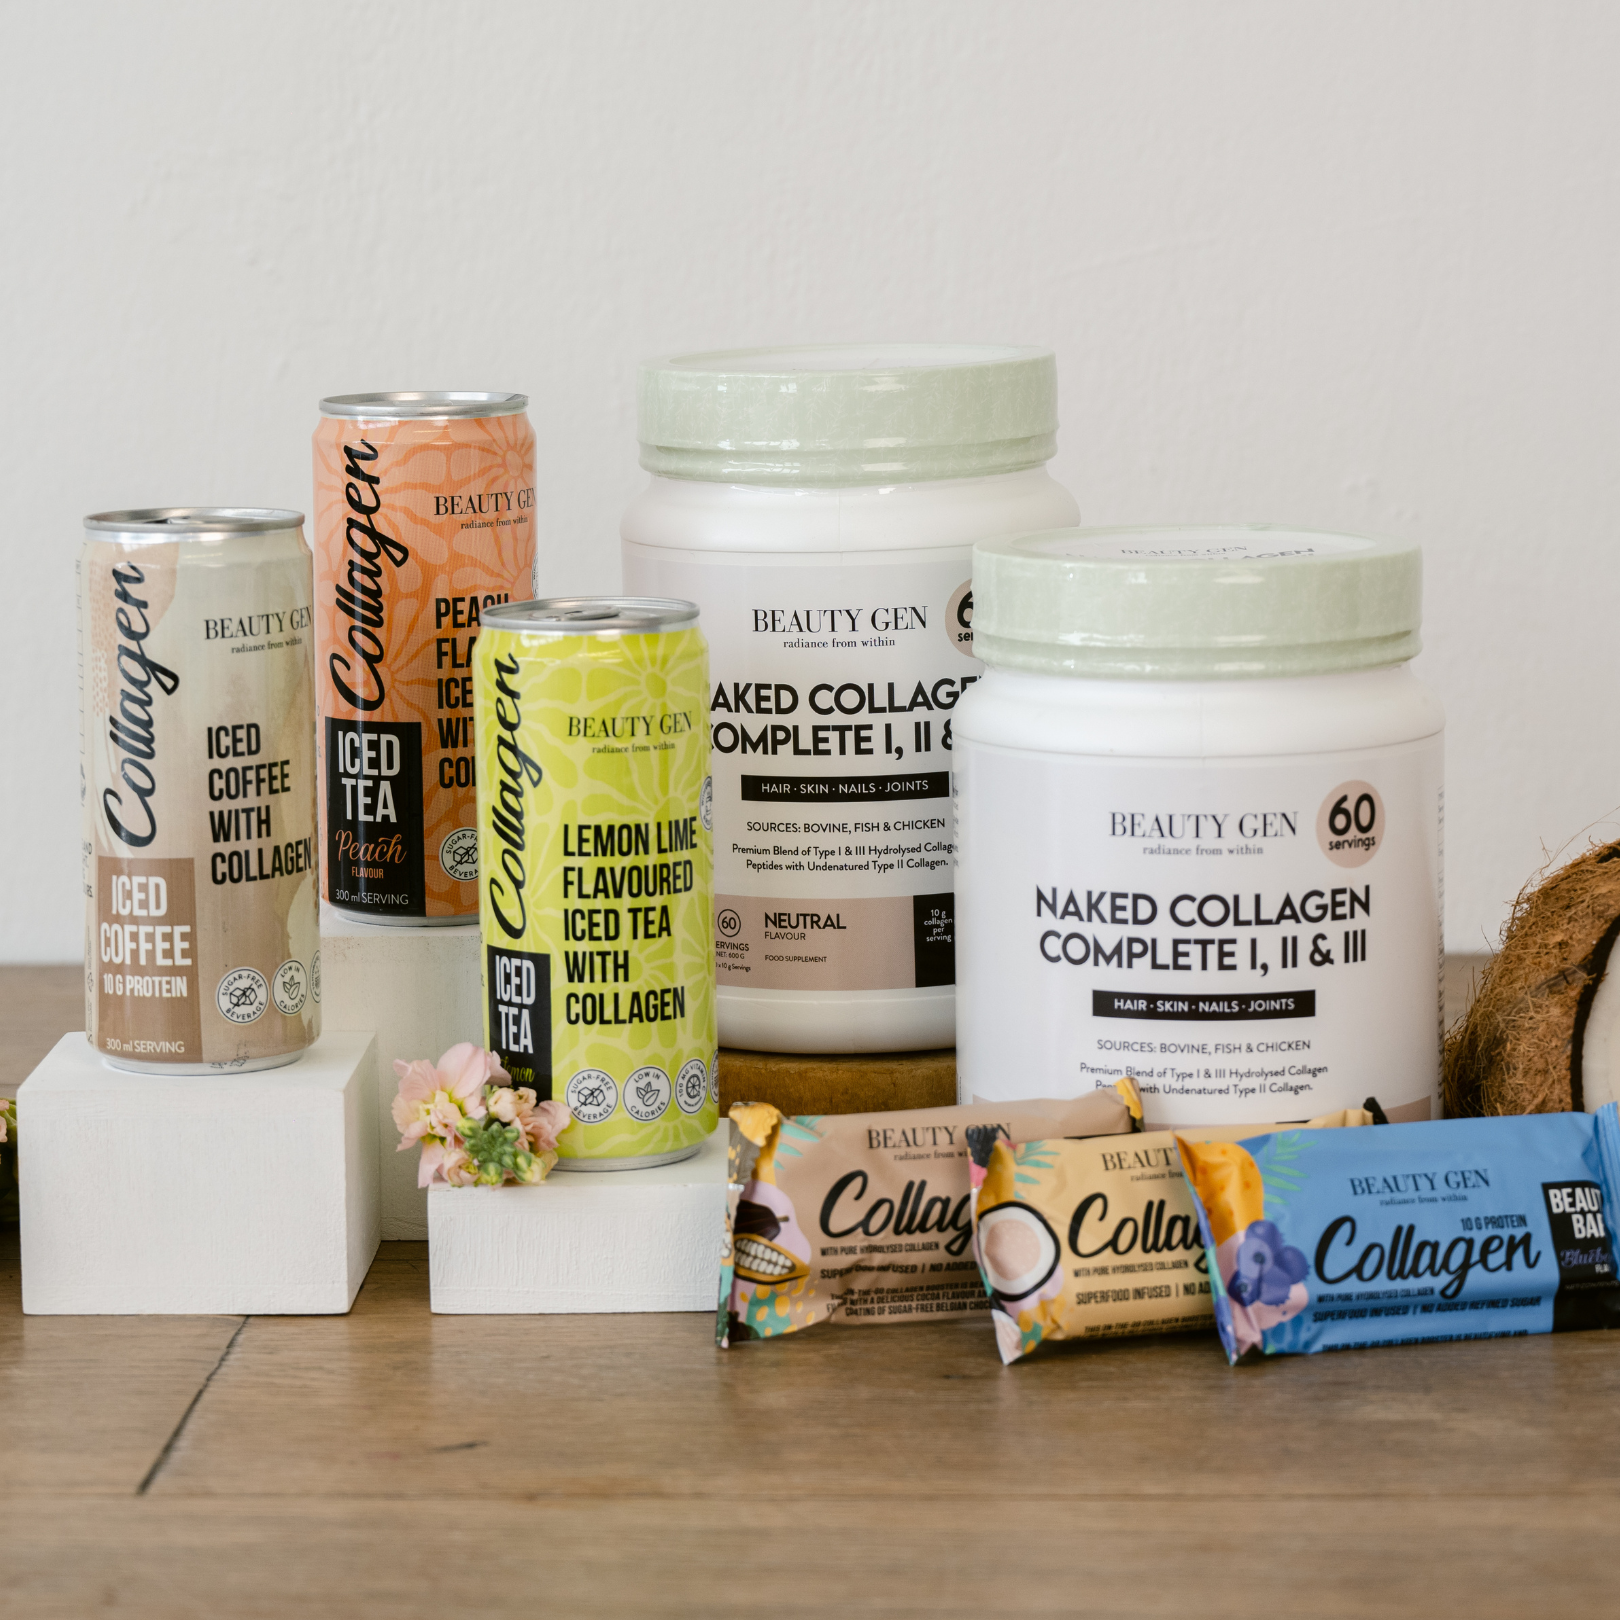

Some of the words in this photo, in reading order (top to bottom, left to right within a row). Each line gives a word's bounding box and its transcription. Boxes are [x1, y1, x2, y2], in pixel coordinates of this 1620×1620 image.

[434, 491, 514, 516] BEAUTY
[461, 520, 494, 530] radiance
[496, 518, 511, 527] from
[513, 516, 528, 525] within
[329, 438, 409, 711] Collagen
[203, 611, 286, 640] BEAUTY
[752, 608, 863, 633] BEAUTY
[870, 605, 928, 631] GEN
[231, 643, 266, 654] radiance
[267, 640, 283, 650] from
[285, 637, 302, 647] within
[783, 637, 829, 649] radiance
[832, 638, 857, 648] from
[861, 637, 896, 647] within
[103, 561, 180, 848] Collagen
[709, 681, 799, 714] AKED
[808, 675, 983, 715] COLLAG
[567, 716, 655, 738] BEAUTY
[660, 711, 692, 734] GEN
[207, 722, 261, 759] ICED
[592, 744, 629, 754] radiance
[632, 742, 650, 754] from
[652, 741, 675, 751] within
[709, 722, 873, 755] OMPLETE
[914, 721, 931, 752] II
[338, 730, 400, 777] ICED
[208, 759, 291, 802] COFFEE
[761, 783, 791, 794] HAIR
[800, 784, 829, 794] SKIN
[838, 782, 876, 794] NAILS
[884, 780, 929, 793] JOINTS
[341, 777, 397, 823] TEA
[489, 653, 543, 939] Collagen
[209, 805, 271, 843] WITH
[1109, 811, 1230, 839] BEAUTY
[1238, 811, 1299, 838] GEN
[1328, 792, 1376, 837] 60
[563, 822, 650, 857] LEMON
[656, 816, 698, 853] LIME
[746, 821, 801, 833] SOURCES:
[803, 822, 852, 836] BOVINE,
[854, 822, 880, 833] FISH
[883, 821, 891, 832] &
[893, 818, 945, 831] CHICKEN
[335, 829, 407, 863] Peach
[732, 843, 771, 855] Premium
[773, 845, 799, 856] Blend
[801, 845, 812, 856] of
[812, 846, 836, 859] Type
[855, 845, 866, 856] III
[868, 843, 921, 858] Hydrolysed
[1142, 844, 1192, 857] radiance
[1195, 844, 1224, 856] from
[1227, 844, 1264, 856] within
[1328, 834, 1376, 852] servings
[211, 837, 312, 885] COLLAGEN
[351, 866, 384, 879] FLAVOUR
[746, 859, 783, 872] Peptides
[785, 861, 805, 871] with
[807, 860, 869, 871] Undenatured
[871, 860, 894, 873] Type
[906, 857, 949, 870] Collagen.
[563, 859, 693, 899] FLAVOURED
[111, 875, 167, 917] ICED
[335, 889, 350, 901] 300
[351, 893, 360, 902] ml
[361, 893, 408, 905] SERVING
[1036, 884, 1158, 926] NAKED
[1169, 884, 1371, 928] COLLAGEN
[564, 908, 620, 941] ICED
[628, 905, 672, 940] TEA
[721, 916, 737, 930] 60
[764, 912, 847, 930] NEUTRAL
[923, 917, 953, 927] collagen
[931, 909, 940, 917] 10
[764, 931, 806, 941] FLAVOUR
[926, 933, 952, 943] serving
[932, 927, 945, 936] per
[100, 922, 192, 966] COFFEE
[1040, 929, 1238, 971] COMPLETE
[1250, 937, 1269, 977] I,
[1281, 934, 1298, 969] II
[1309, 933, 1335, 967] &
[1344, 928, 1367, 964] III
[565, 950, 629, 983] WITH
[764, 954, 784, 962] FOOD
[784, 955, 827, 963] SUPPLEMENT
[103, 974, 115, 995] 10
[116, 976, 123, 996] G
[125, 976, 187, 998] PROTEIN
[222, 973, 264, 997] SUGAR-FREE
[495, 955, 536, 1005] ICED
[225, 1001, 264, 1021] BEVERAGE
[566, 986, 685, 1025] COLLAGEN
[1114, 998, 1147, 1011] HAIR
[1156, 999, 1189, 1012] SKIN
[1199, 999, 1239, 1013] NAILS
[1248, 998, 1295, 1012] JOINTS
[498, 1004, 534, 1054] TEA
[106, 1038, 122, 1051] 300
[123, 1041, 133, 1052] ml
[134, 1041, 185, 1053] SERVING
[1097, 1039, 1157, 1053] SOURCES:
[1160, 1043, 1212, 1056] BOVINE,
[1215, 1043, 1242, 1054] FISH
[1245, 1043, 1254, 1053] &
[1257, 1040, 1311, 1053] CHICKEN
[571, 1073, 613, 1094] SUGAR-FREE
[633, 1071, 651, 1083] LOW
[1080, 1062, 1123, 1076] Premium
[1125, 1066, 1154, 1078] Blend
[1157, 1068, 1168, 1078] of
[1170, 1068, 1194, 1082] Type
[1215, 1068, 1226, 1079] III
[1229, 1067, 1285, 1082] Hydrolysed
[1288, 1065, 1329, 1078] Collagen
[1163, 1084, 1230, 1095] Undenatured
[1232, 1084, 1257, 1097] Type
[1269, 1081, 1313, 1095] Collagen.
[573, 1102, 613, 1120] BEVERAGE
[630, 1101, 666, 1118] CALORIES
[867, 1126, 958, 1149] BEAUTY
[1349, 1172, 1437, 1196] BEAUTY
[1444, 1168, 1491, 1189] GEN
[819, 1169, 973, 1256] Collag
[1460, 1217, 1473, 1231] 10
[1475, 1217, 1482, 1230] G
[1483, 1214, 1527, 1230] PROTEIN
[840, 1245, 857, 1254] PURE
[905, 1241, 939, 1252] COLLAGEN
[1314, 1215, 1542, 1301] Collagen
[929, 1263, 943, 1272] NO
[1155, 1259, 1188, 1271] COLLAGEN
[1076, 1288, 1130, 1305] SUPERFOOD
[1133, 1285, 1171, 1299] INFUSED
[1183, 1282, 1196, 1295] NO
[888, 1303, 934, 1315] SUGAR-FREE
